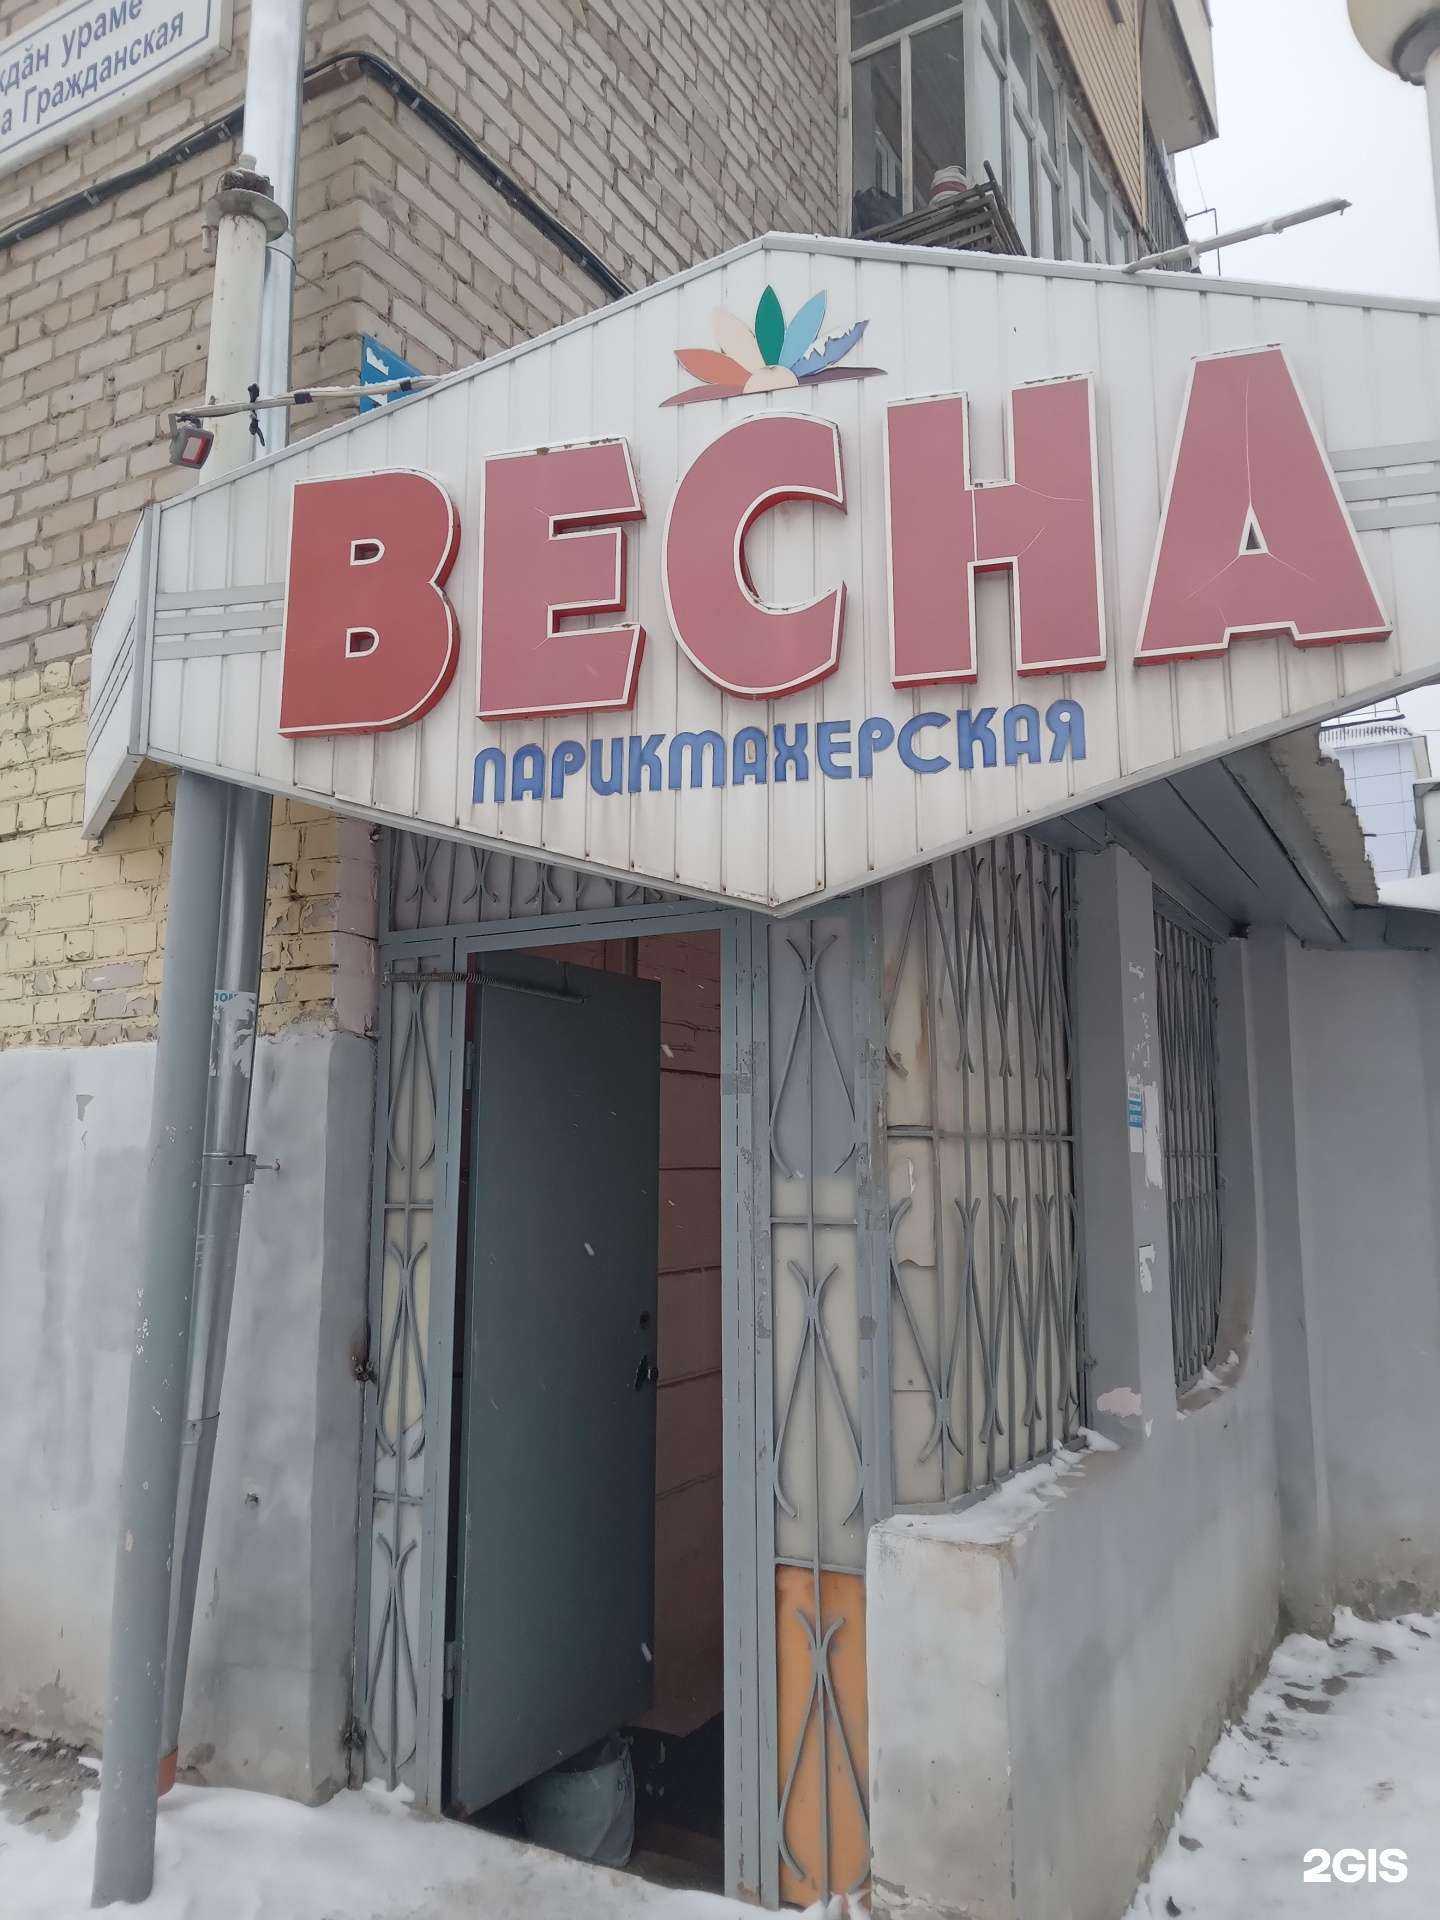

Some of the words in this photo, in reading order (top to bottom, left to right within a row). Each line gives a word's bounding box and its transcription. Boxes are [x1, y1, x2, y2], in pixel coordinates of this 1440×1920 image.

[22, 11, 184, 125] Гражданская
[278, 343, 1392, 740] ВЕСНА
[472, 699, 1087, 804] ПАРИКМАХЕРСКАЯ
